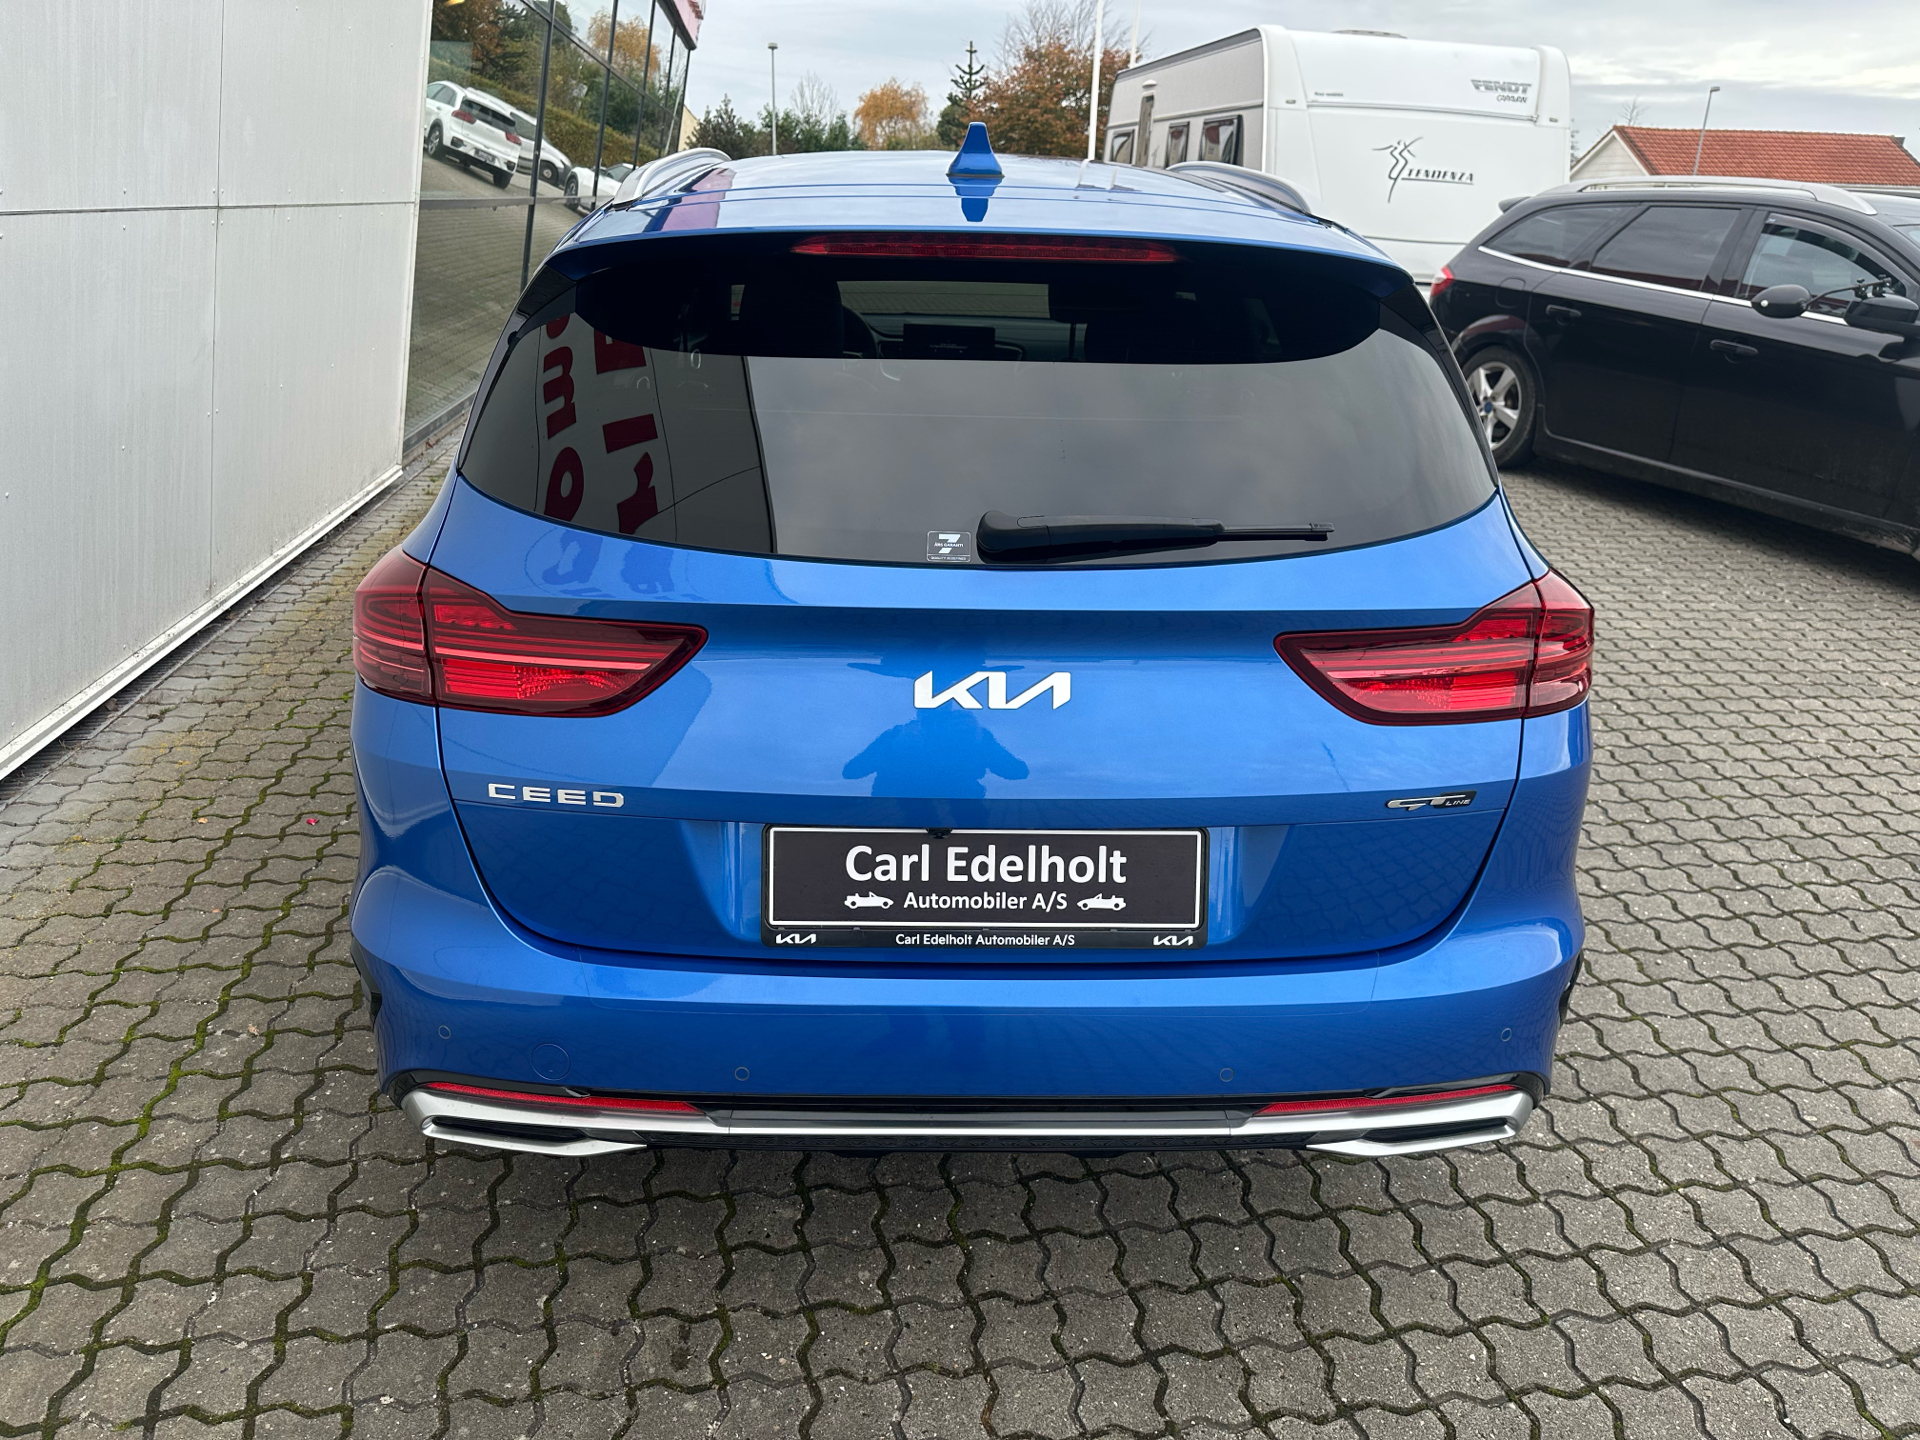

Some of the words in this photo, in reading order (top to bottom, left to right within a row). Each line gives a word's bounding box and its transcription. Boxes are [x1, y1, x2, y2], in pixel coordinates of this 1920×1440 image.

[1470, 79, 1532, 94] FENDT
[1407, 168, 1474, 182] TENDENZA
[914, 670, 1071, 710] KIA
[488, 783, 624, 808] CEED
[845, 843, 930, 882] Carl
[946, 844, 1127, 884] Edelholt
[903, 891, 1028, 910] Automobiler
[1032, 891, 1068, 912] A/S
[775, 933, 817, 944] KIA
[895, 934, 920, 945] Carl
[923, 934, 973, 945] Edelholt
[975, 934, 1050, 946] Automobiler
[1052, 934, 1075, 946] A/S
[1153, 935, 1194, 946] KIA
